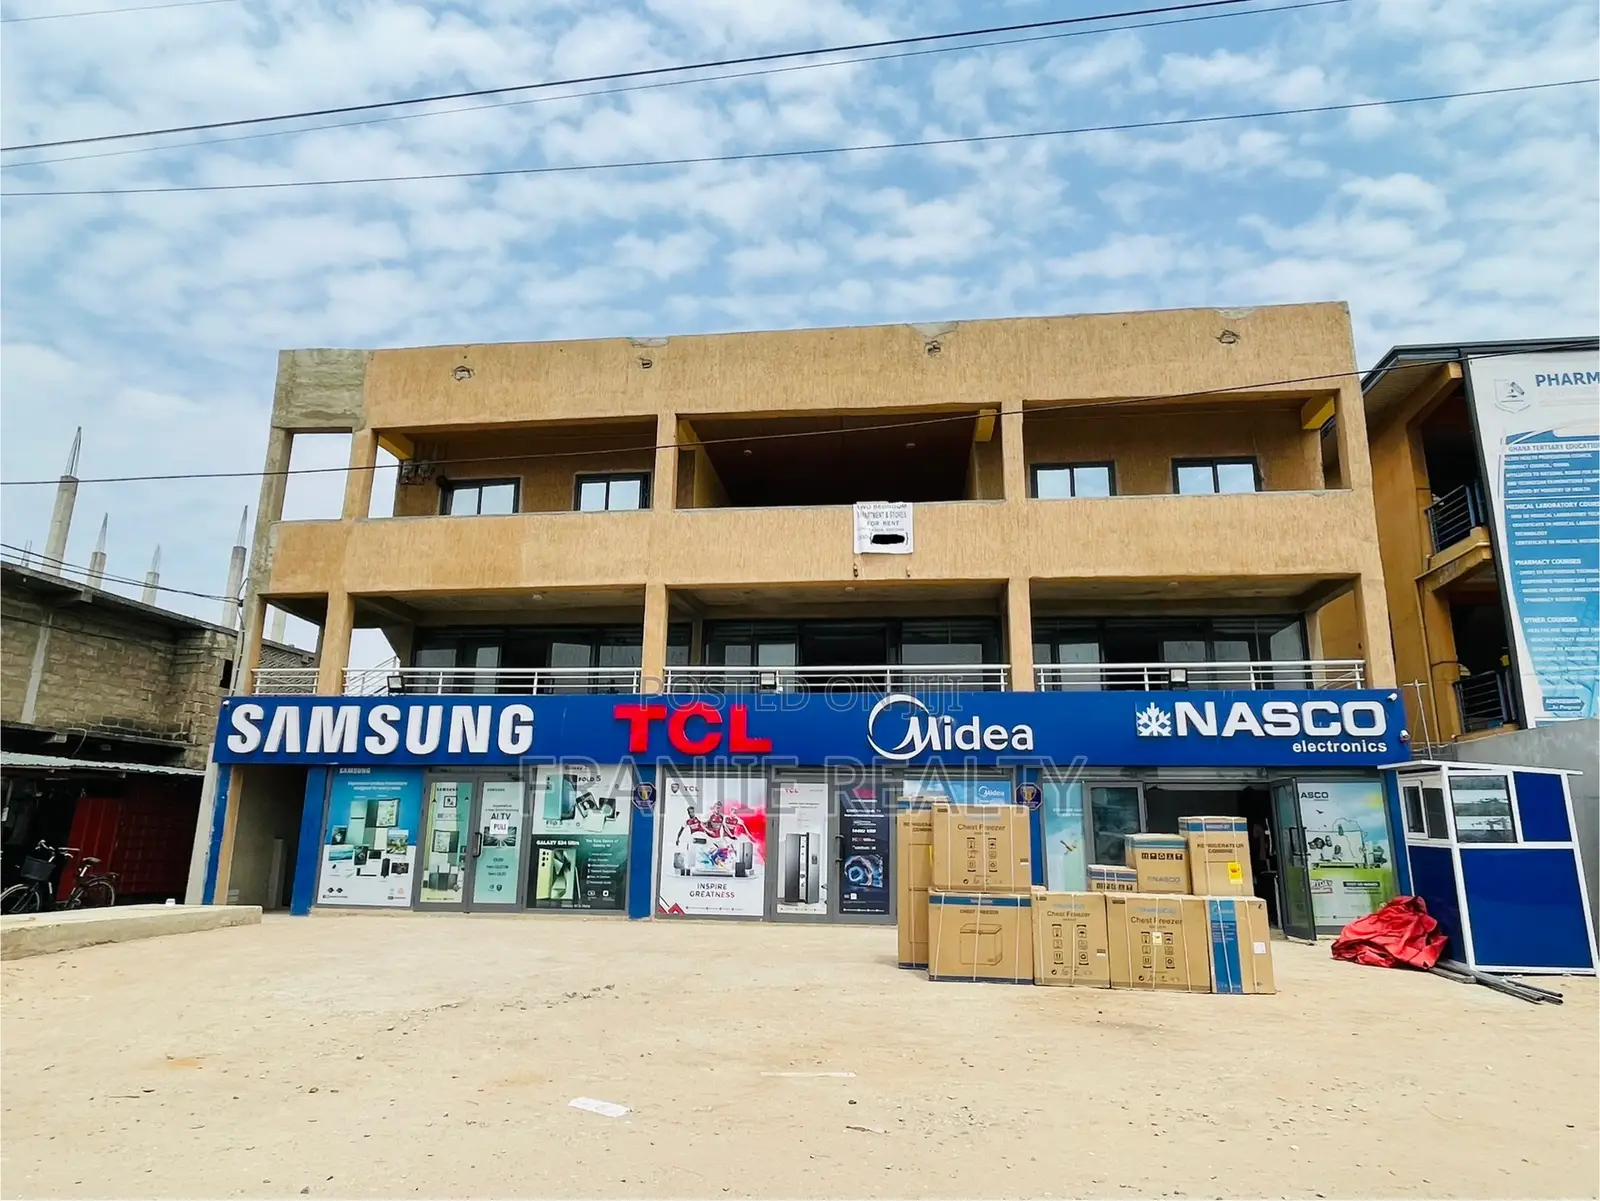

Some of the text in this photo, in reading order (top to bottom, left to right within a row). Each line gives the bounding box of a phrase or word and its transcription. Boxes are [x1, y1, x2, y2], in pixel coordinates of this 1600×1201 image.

[1535, 501, 1578, 509] LABORATORY
[1174, 700, 1387, 737] NASCO
[227, 704, 534, 755] SAMSUNG
[613, 701, 773, 755] TCL
[1292, 740, 1387, 753] electronics
[683, 785, 700, 793] TCL
[1300, 791, 1329, 799] ASCO
[689, 890, 735, 898] GREATNESS
[1130, 916, 1152, 924] Chest
